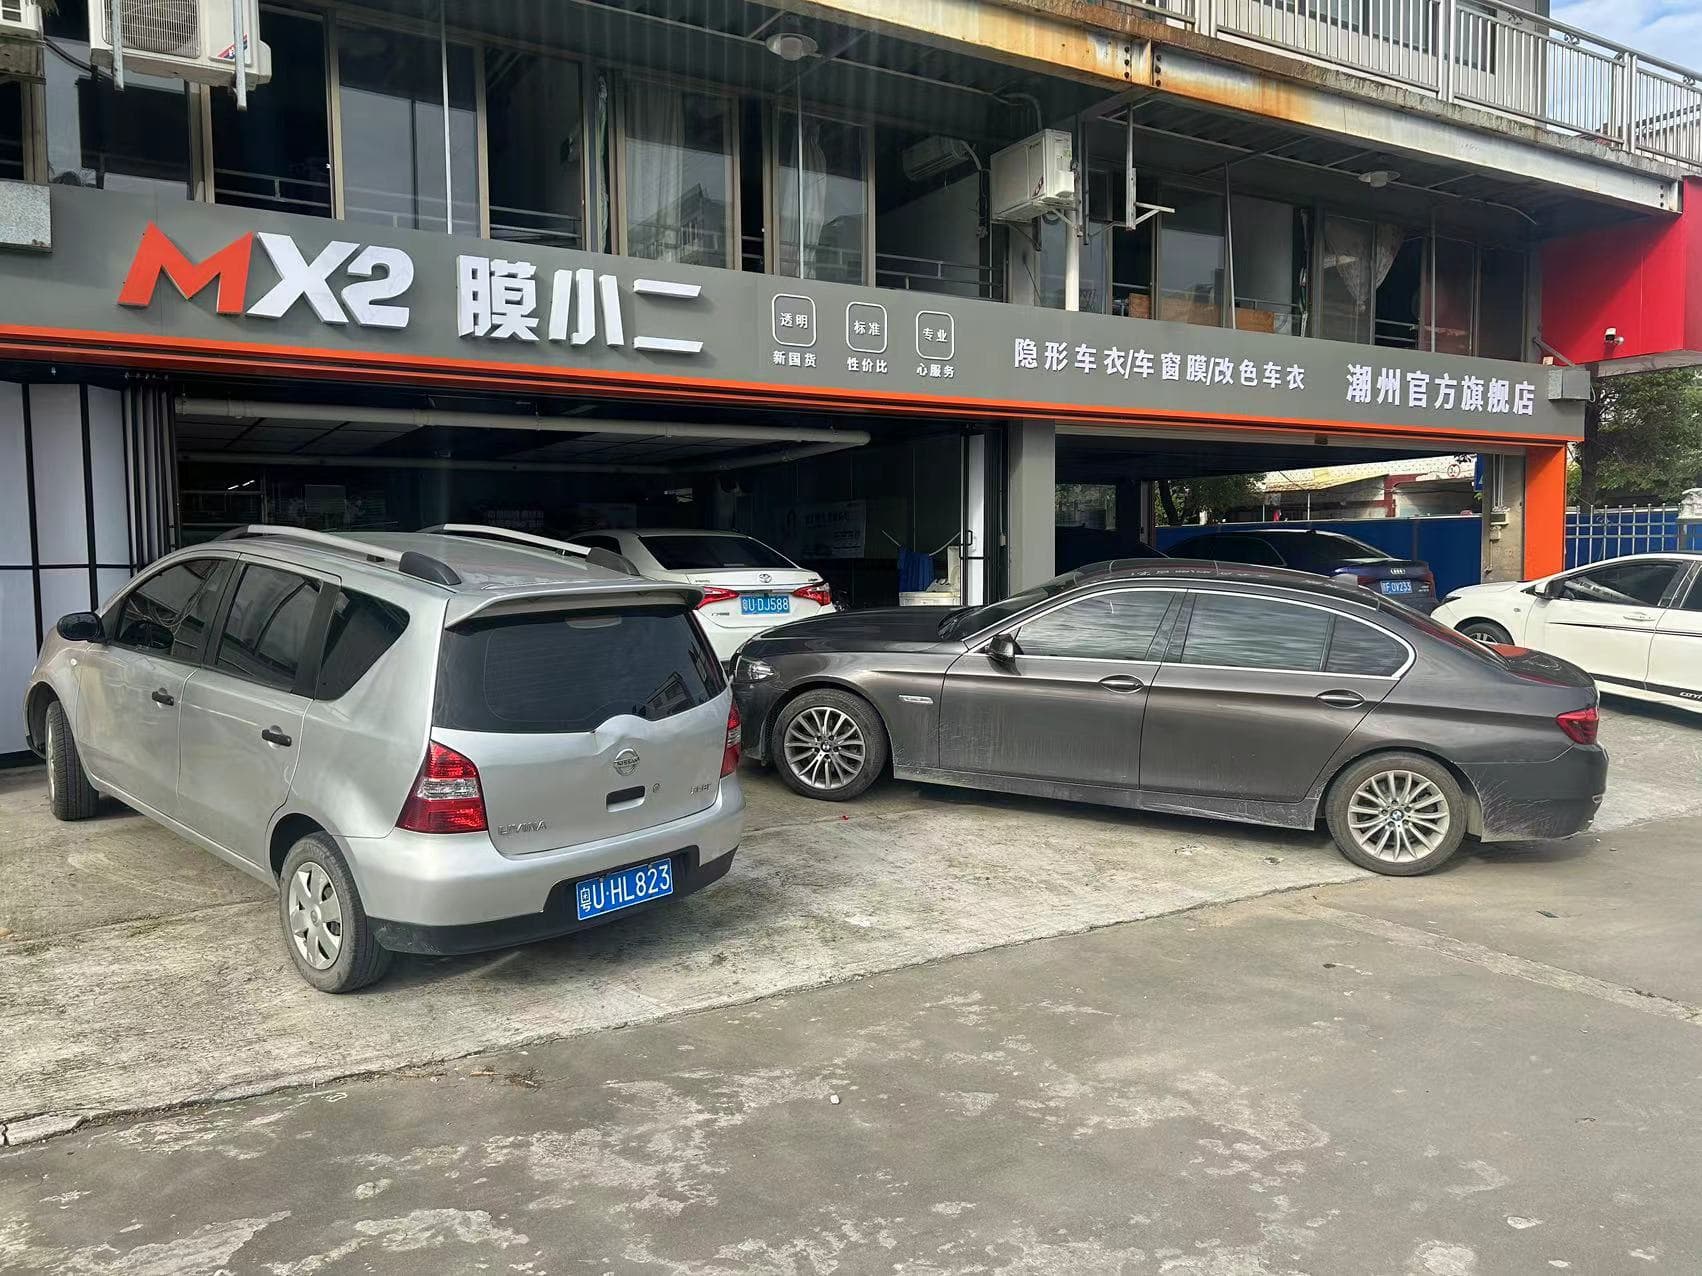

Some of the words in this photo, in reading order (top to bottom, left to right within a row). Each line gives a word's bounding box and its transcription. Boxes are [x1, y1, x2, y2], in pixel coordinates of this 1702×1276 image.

[117, 219, 415, 330] MX2
[456, 254, 703, 354] 膜小二
[779, 311, 809, 329] 透明
[853, 319, 881, 337] 标准
[922, 327, 948, 344] 专业
[772, 350, 818, 369] 新国货
[847, 356, 889, 374] 性价比
[1013, 337, 1305, 391] 隐形车衣/车窗膜/改色车衣
[916, 361, 956, 380] 心服务
[1345, 362, 1536, 415] 潮州官方旗舰店
